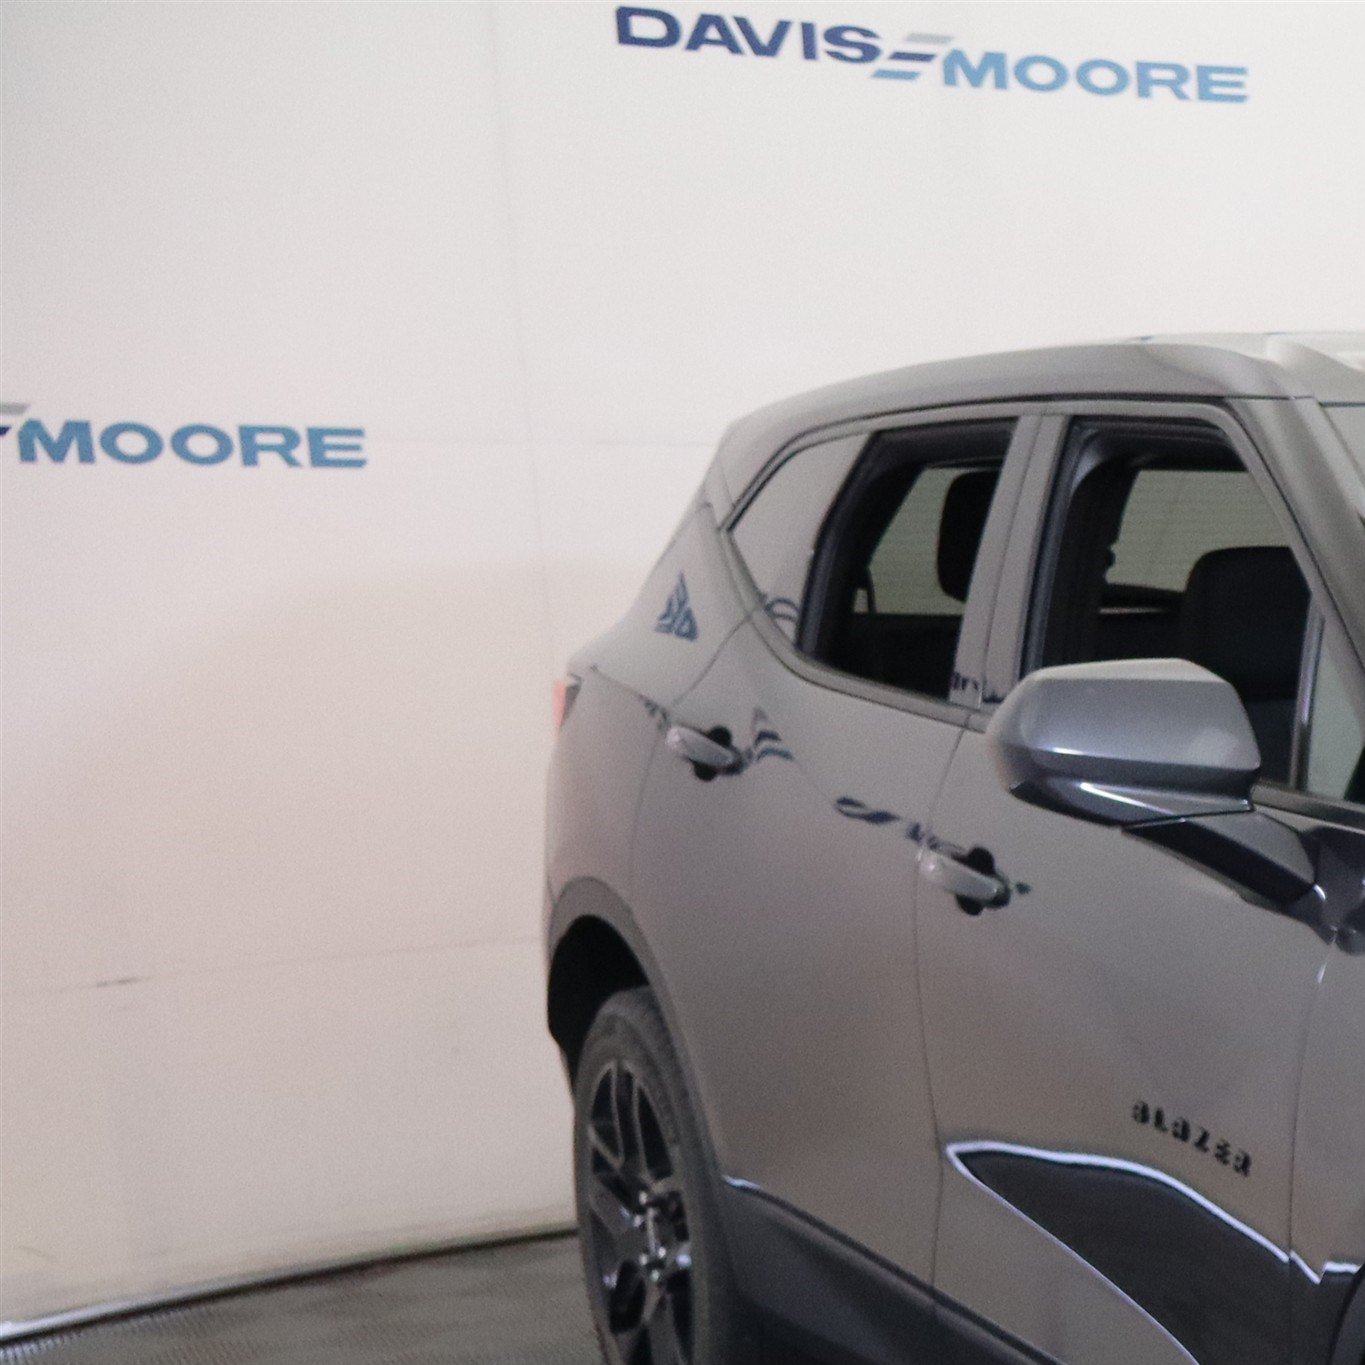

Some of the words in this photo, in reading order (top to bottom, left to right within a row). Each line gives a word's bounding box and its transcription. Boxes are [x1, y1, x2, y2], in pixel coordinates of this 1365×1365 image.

[614, 4, 884, 66] DAVIS
[941, 47, 1249, 104] MOORE
[15, 417, 369, 470] MOORE
